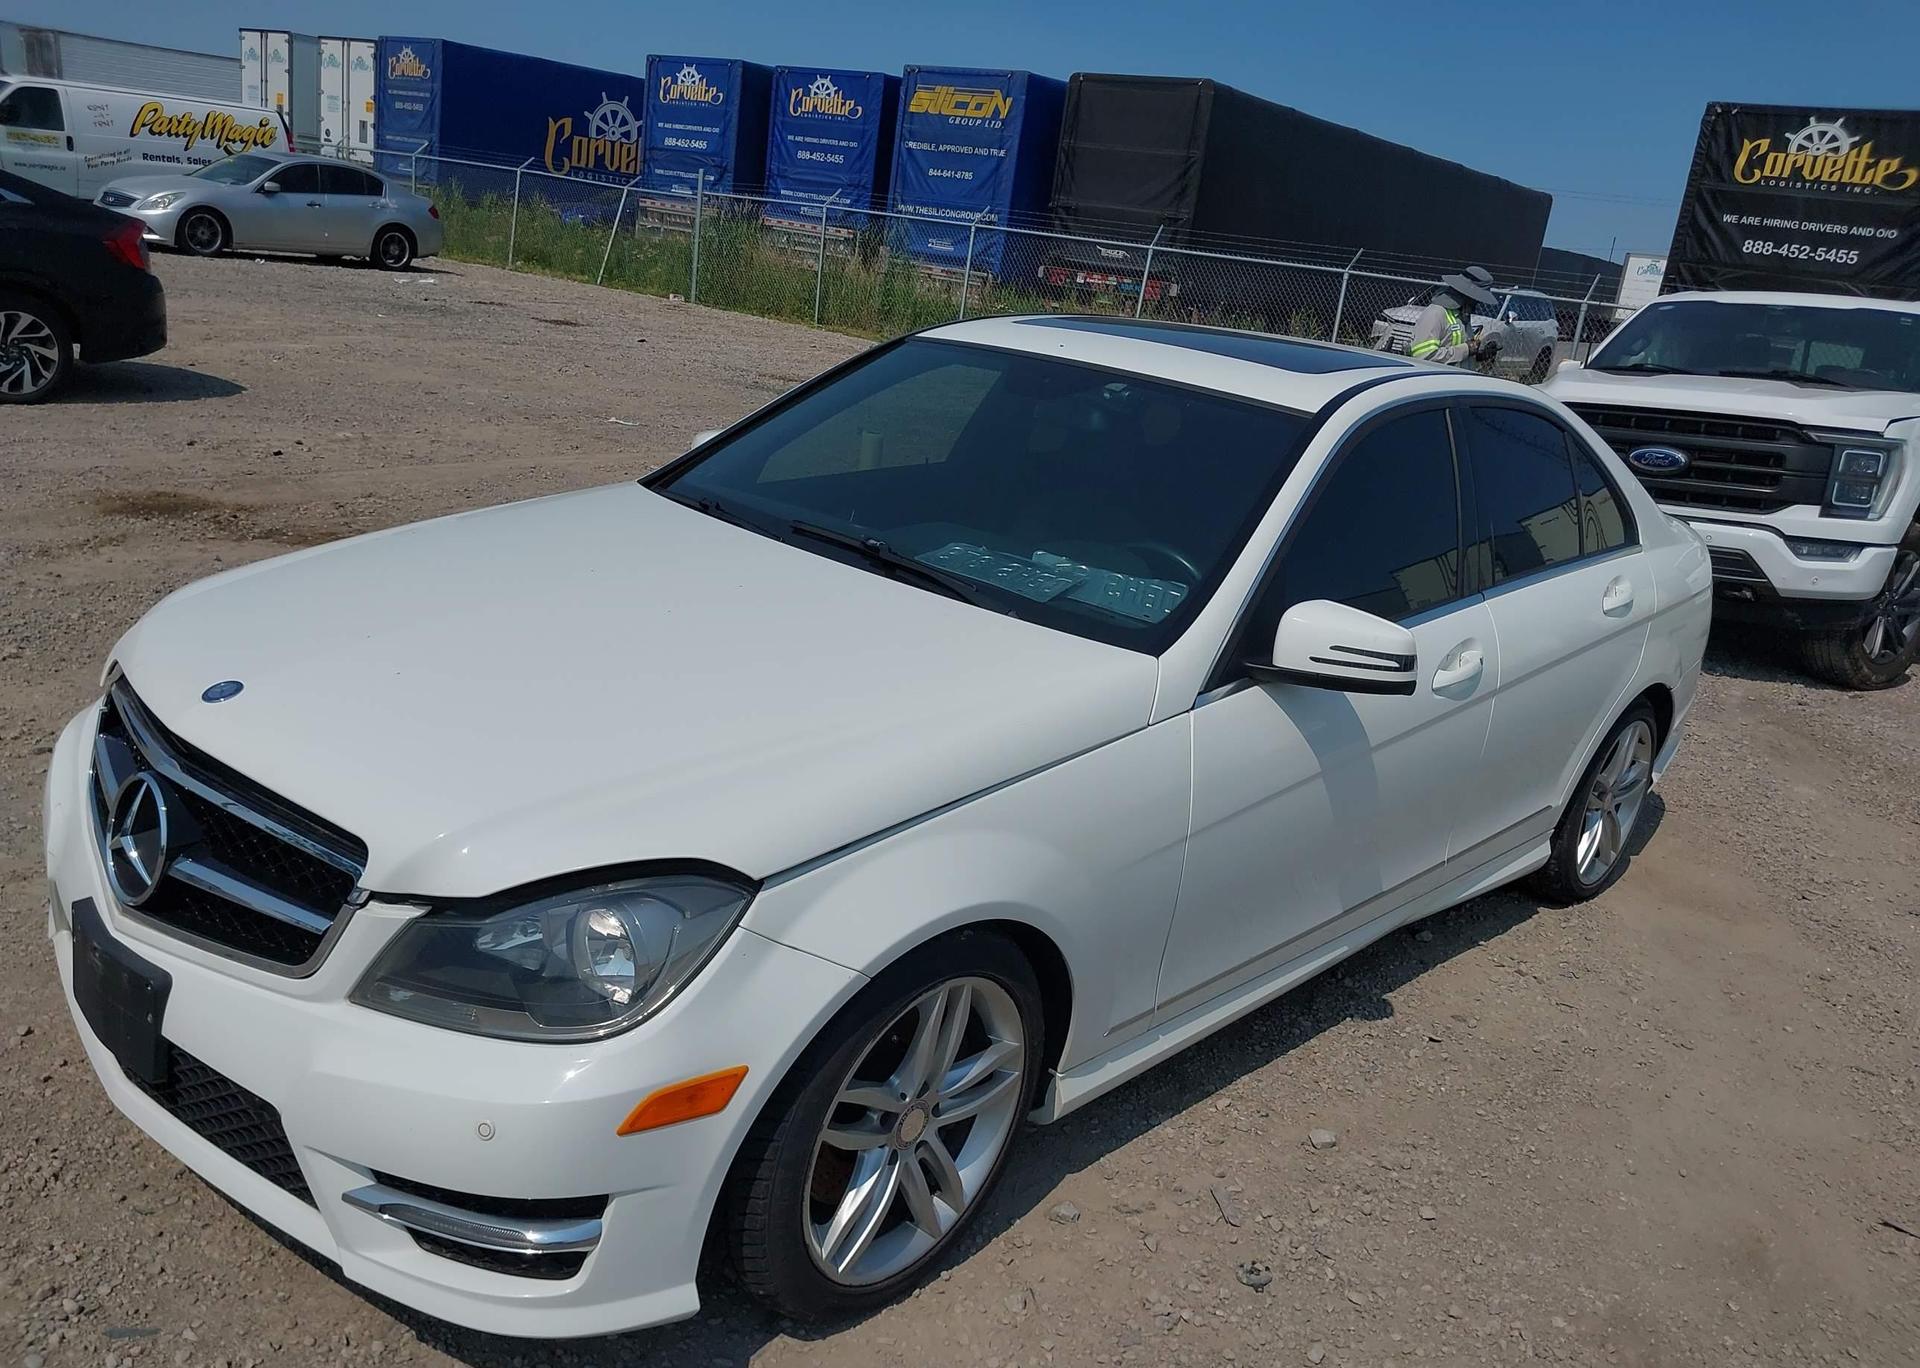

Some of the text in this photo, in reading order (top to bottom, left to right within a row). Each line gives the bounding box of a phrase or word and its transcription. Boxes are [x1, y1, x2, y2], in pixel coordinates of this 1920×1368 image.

[659, 77, 723, 105] Corvette
[789, 88, 863, 119] Corvette
[948, 116, 1005, 129] GROUP LTD.
[664, 137, 709, 150] 888-452-5455
[904, 141, 1007, 158] CREDIBLE, APPROVED AND TRUE
[142, 152, 212, 166] Rentals, Sales
[797, 150, 845, 165] 888-452-5455
[1733, 138, 1920, 191] Corvette
[928, 168, 974, 181] 844-641-8785
[1760, 179, 1880, 196] LOGISTICS INC.
[1722, 213, 1899, 240] WE ARE HIRING DRIVERS AND O/O
[1742, 239, 1860, 264] 888-452-5455
[1641, 452, 1672, 466] Ford
